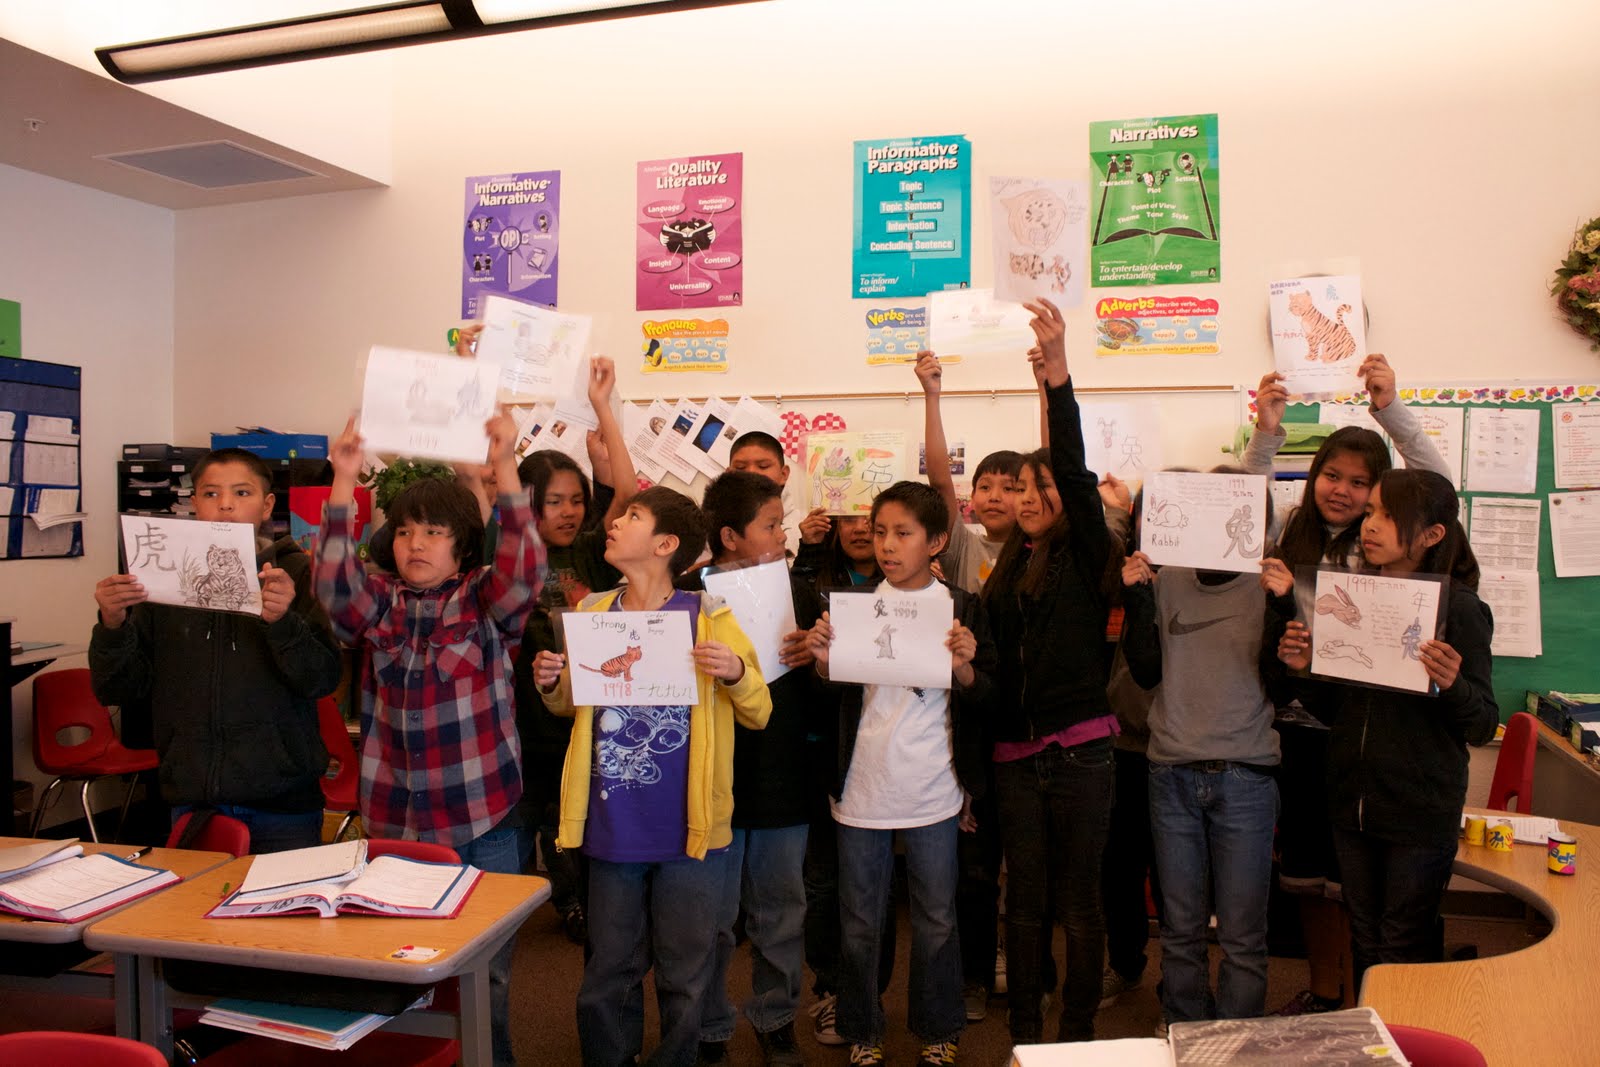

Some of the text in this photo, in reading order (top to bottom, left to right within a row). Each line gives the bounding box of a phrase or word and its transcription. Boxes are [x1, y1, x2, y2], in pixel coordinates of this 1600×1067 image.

[1110, 125, 1198, 143] Narratives
[868, 143, 959, 160] Informative
[668, 160, 722, 176] Quality
[868, 156, 958, 174] Paragraphs
[656, 173, 728, 189] Literature
[901, 182, 922, 192] Topic
[480, 192, 546, 206] Narratives
[648, 204, 680, 213] Language
[882, 202, 942, 212] Topic Sentence
[1159, 202, 1176, 210] View
[1117, 214, 1140, 224] Theme
[1172, 212, 1190, 220] Style
[888, 222, 934, 231] Information
[492, 230, 529, 248] TOPIC
[870, 240, 952, 252] Concluding Sentence
[649, 260, 672, 268] Insight
[704, 256, 731, 264] Content
[1100, 266, 1110, 274] To
[1111, 262, 1182, 273] entertain/develop
[870, 276, 899, 284] inform/
[1099, 272, 1157, 282] understanding
[670, 282, 710, 291] Universality
[860, 286, 886, 295] explain
[1100, 298, 1155, 316] Adverbs
[1138, 308, 1166, 316] adjectives,
[868, 309, 905, 326] Verbs
[644, 320, 697, 336] Pronouns
[1229, 479, 1245, 488] 1999
[130, 522, 177, 571] 虎
[1152, 534, 1181, 548] Rabbit
[1347, 576, 1376, 594] 1999
[1412, 588, 1433, 612] 年
[592, 615, 626, 633] Strong
